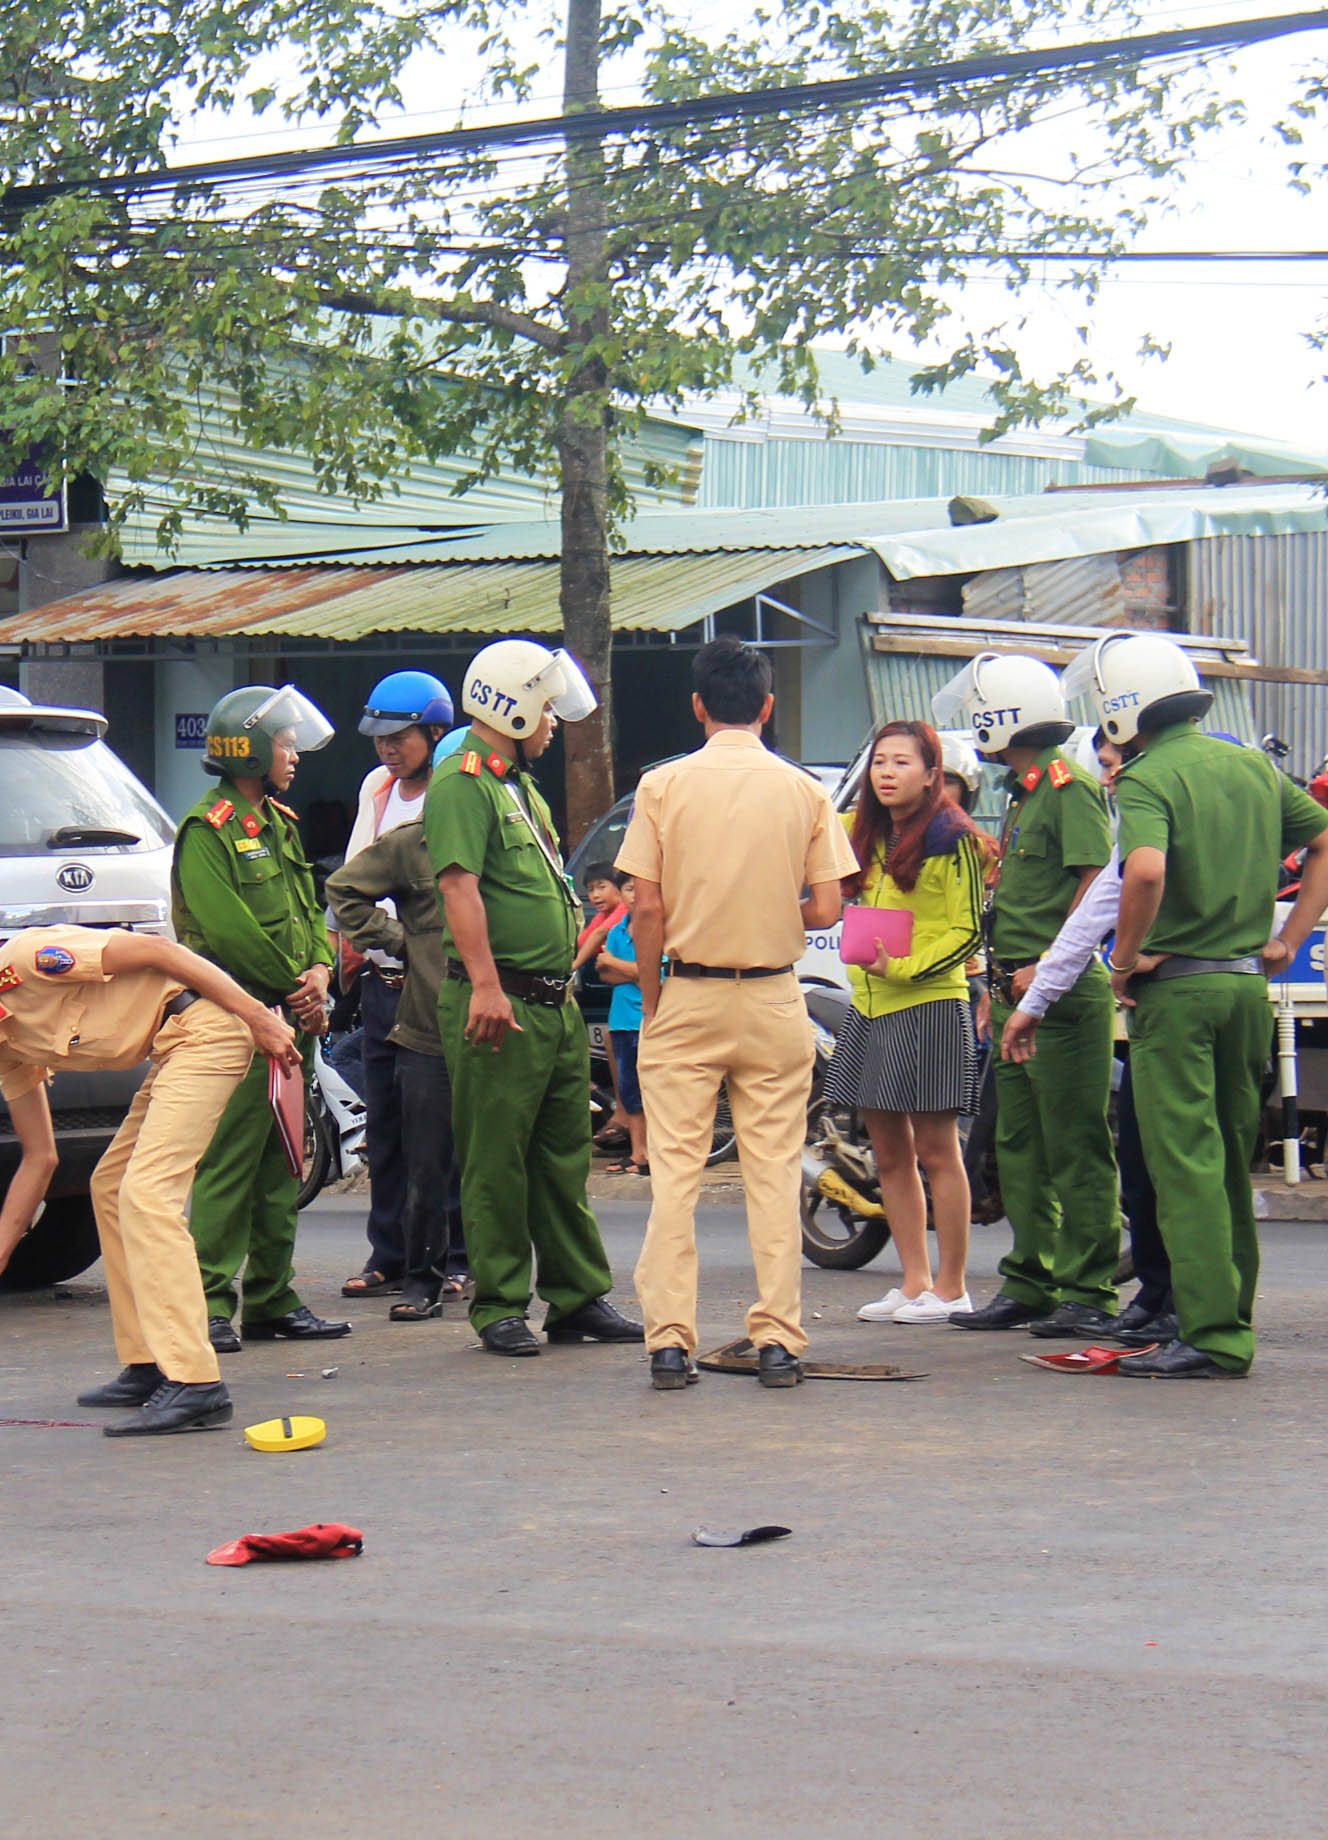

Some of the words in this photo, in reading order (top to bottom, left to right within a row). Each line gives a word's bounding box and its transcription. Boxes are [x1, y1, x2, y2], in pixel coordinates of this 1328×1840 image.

[18, 475, 33, 486] LAI
[41, 507, 54, 518] LAI
[1102, 691, 1140, 714] CSTT
[177, 717, 206, 738] 403
[972, 707, 1021, 730] CSTT
[207, 735, 252, 758] CS113
[63, 870, 89, 886] KIA
[805, 935, 840, 950] POLI
